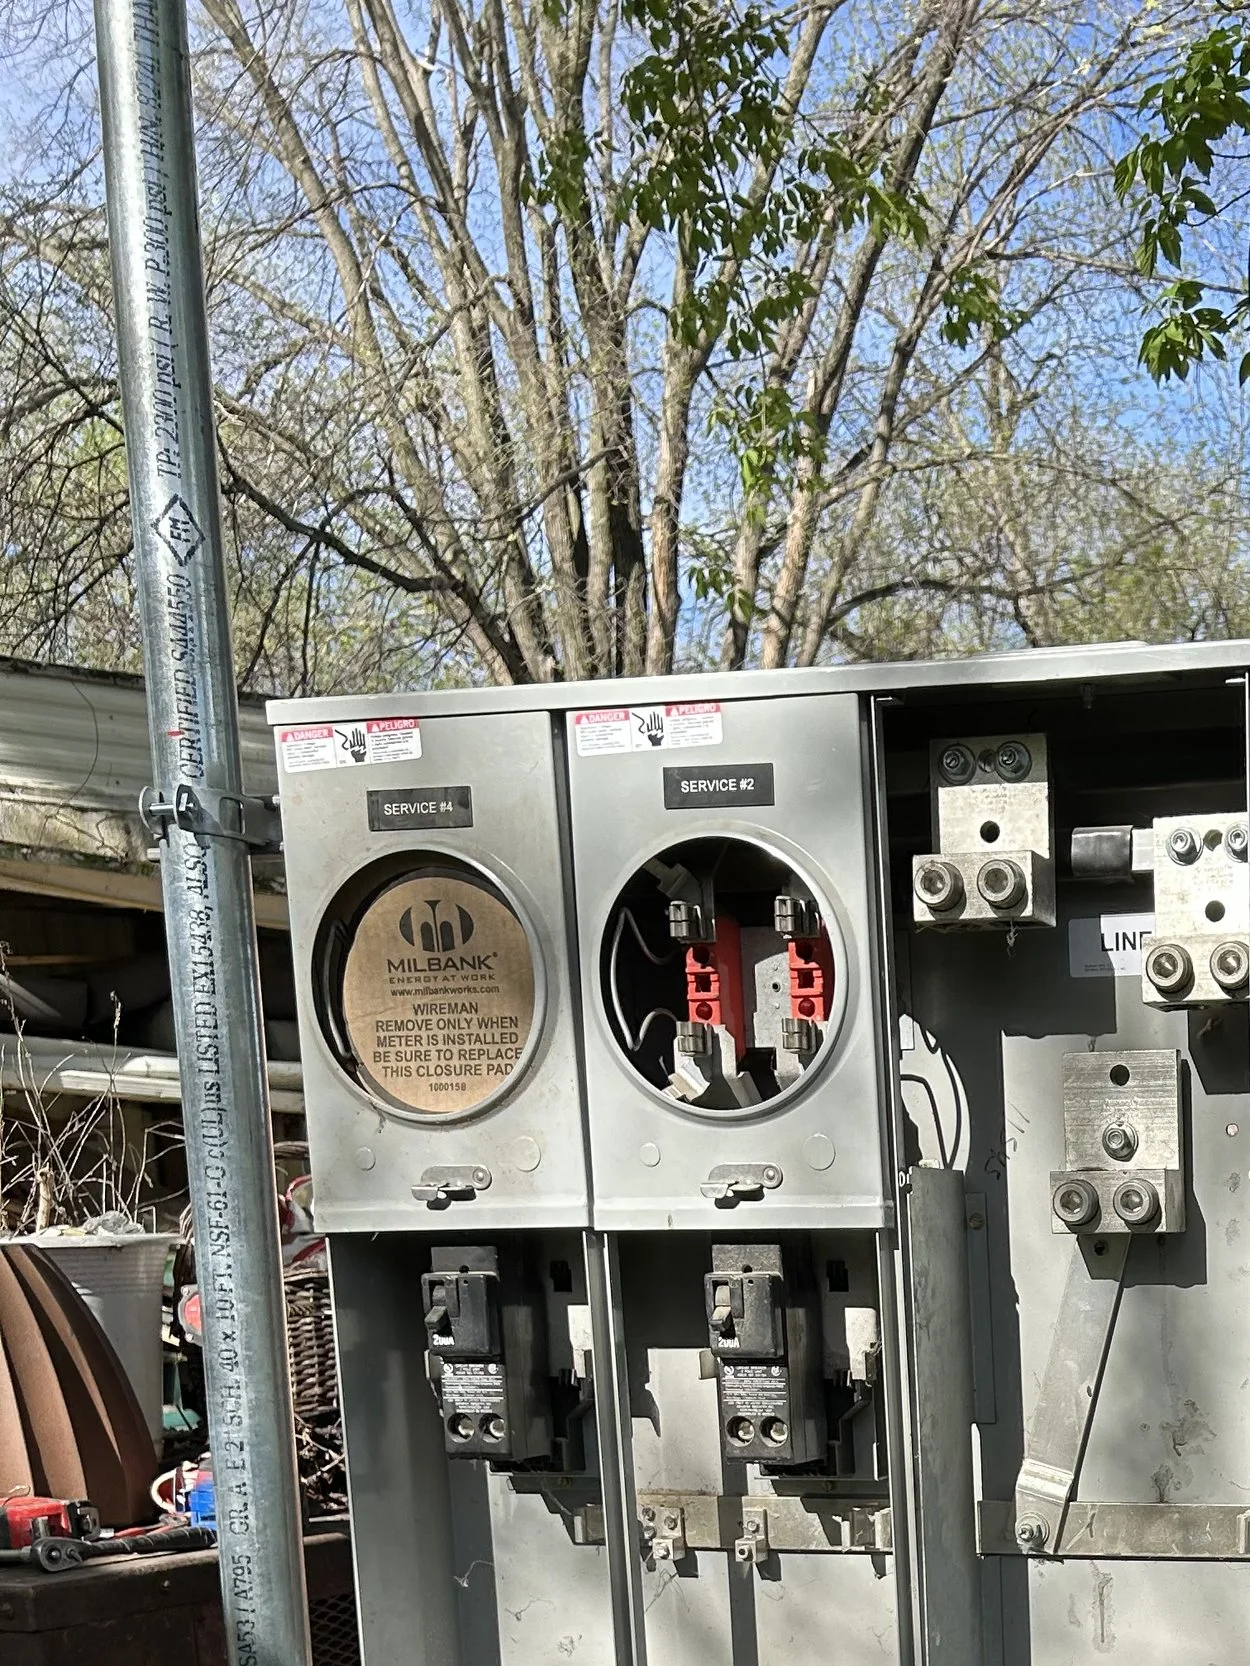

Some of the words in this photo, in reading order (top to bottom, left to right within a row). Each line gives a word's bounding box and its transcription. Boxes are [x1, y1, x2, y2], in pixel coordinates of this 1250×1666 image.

[142, 180, 172, 217] psi
[150, 352, 180, 388] psi
[153, 390, 179, 442] 2300
[679, 704, 716, 714] PELIGRO
[174, 668, 204, 780] CERTIFIED
[590, 712, 624, 722] DANGER
[380, 720, 415, 731] PELIGRO
[293, 729, 329, 740] DANGER
[681, 779, 737, 793] SERVICE
[739, 778, 754, 790] #2
[384, 802, 436, 815] SERVICE
[440, 801, 453, 812] #4
[183, 842, 210, 899] ALSO
[389, 976, 438, 984] ENERGY
[390, 985, 500, 996] www.milbankworks.com
[413, 1002, 478, 1015] WIREMAN
[376, 1019, 432, 1032] REMOVE
[437, 1018, 473, 1030] ONLY
[477, 1016, 518, 1029] WHEN
[193, 1002, 221, 1076] LISTED
[377, 1035, 423, 1048] METER
[427, 1034, 438, 1046] IS
[443, 1032, 518, 1045] INSTALLED
[373, 1051, 391, 1062] BE
[395, 1050, 432, 1062] SURE
[436, 1049, 453, 1060] TO
[458, 1048, 522, 1060] REPLACE
[382, 1066, 412, 1078] THIS
[416, 1064, 482, 1076] CLOSURE
[487, 1063, 514, 1075] PAD
[429, 1083, 466, 1091] 1000158
[216, 1348, 238, 1372] 40
[227, 1482, 247, 1496] A
[230, 1554, 253, 1600] A795
[236, 1620, 258, 1666] SA53
